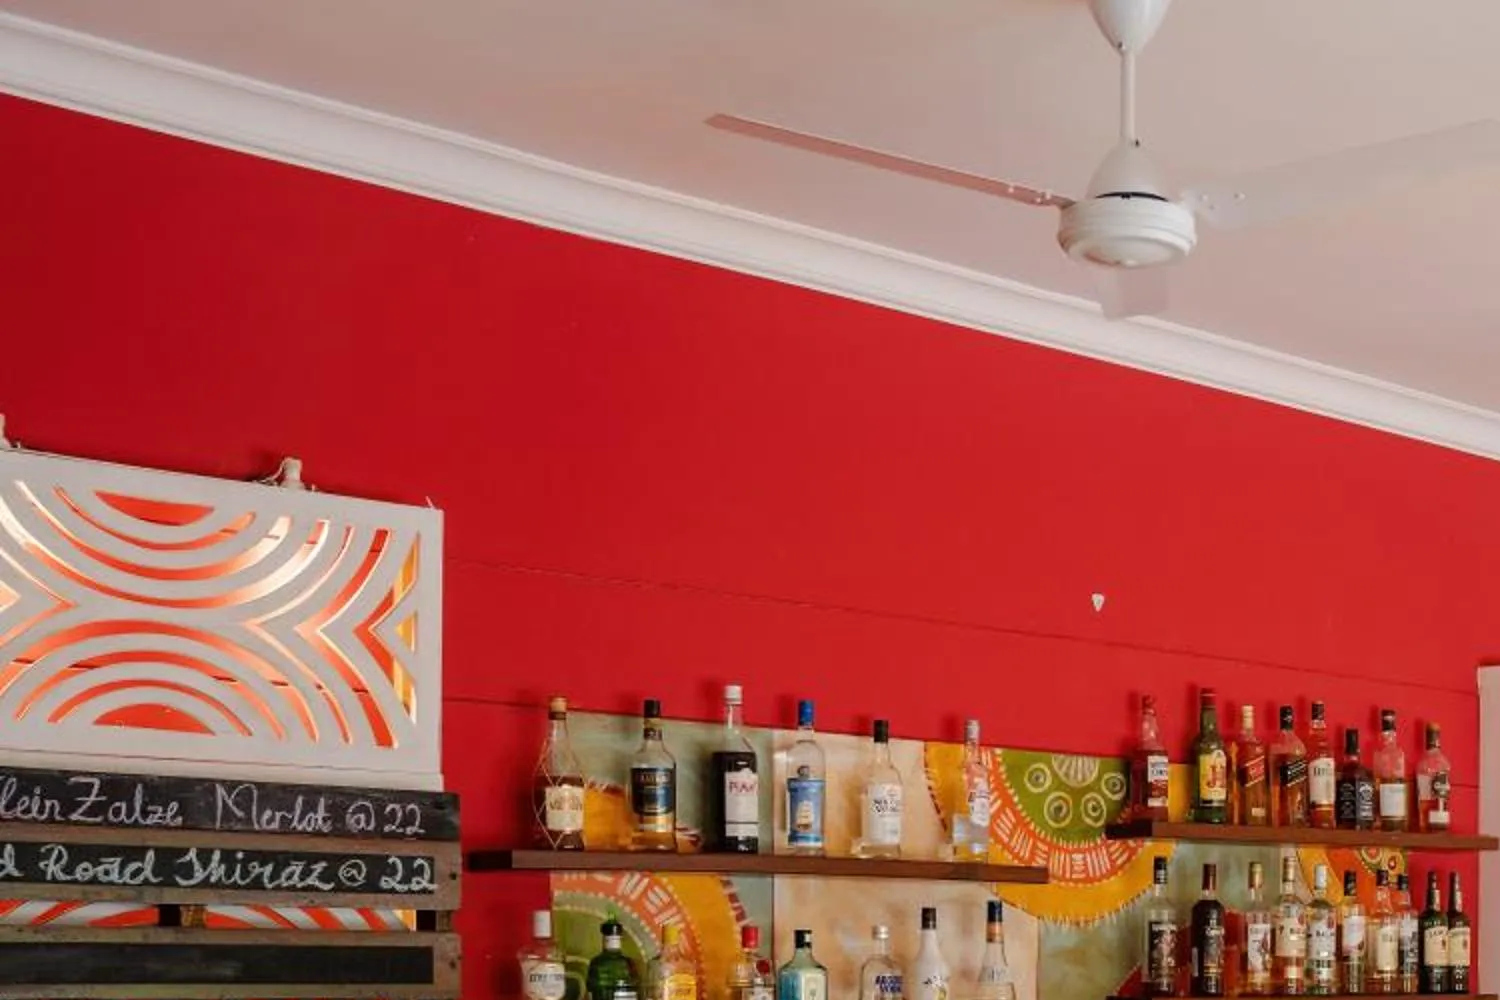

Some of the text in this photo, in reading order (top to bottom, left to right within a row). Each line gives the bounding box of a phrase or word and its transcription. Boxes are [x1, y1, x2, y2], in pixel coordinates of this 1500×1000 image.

[0, 776, 426, 835] lein Zalze Merlot @ 22
[39, 843, 164, 885] Road
[174, 847, 336, 890] Shiraz
[338, 859, 367, 887] @
[379, 855, 438, 892] 22
